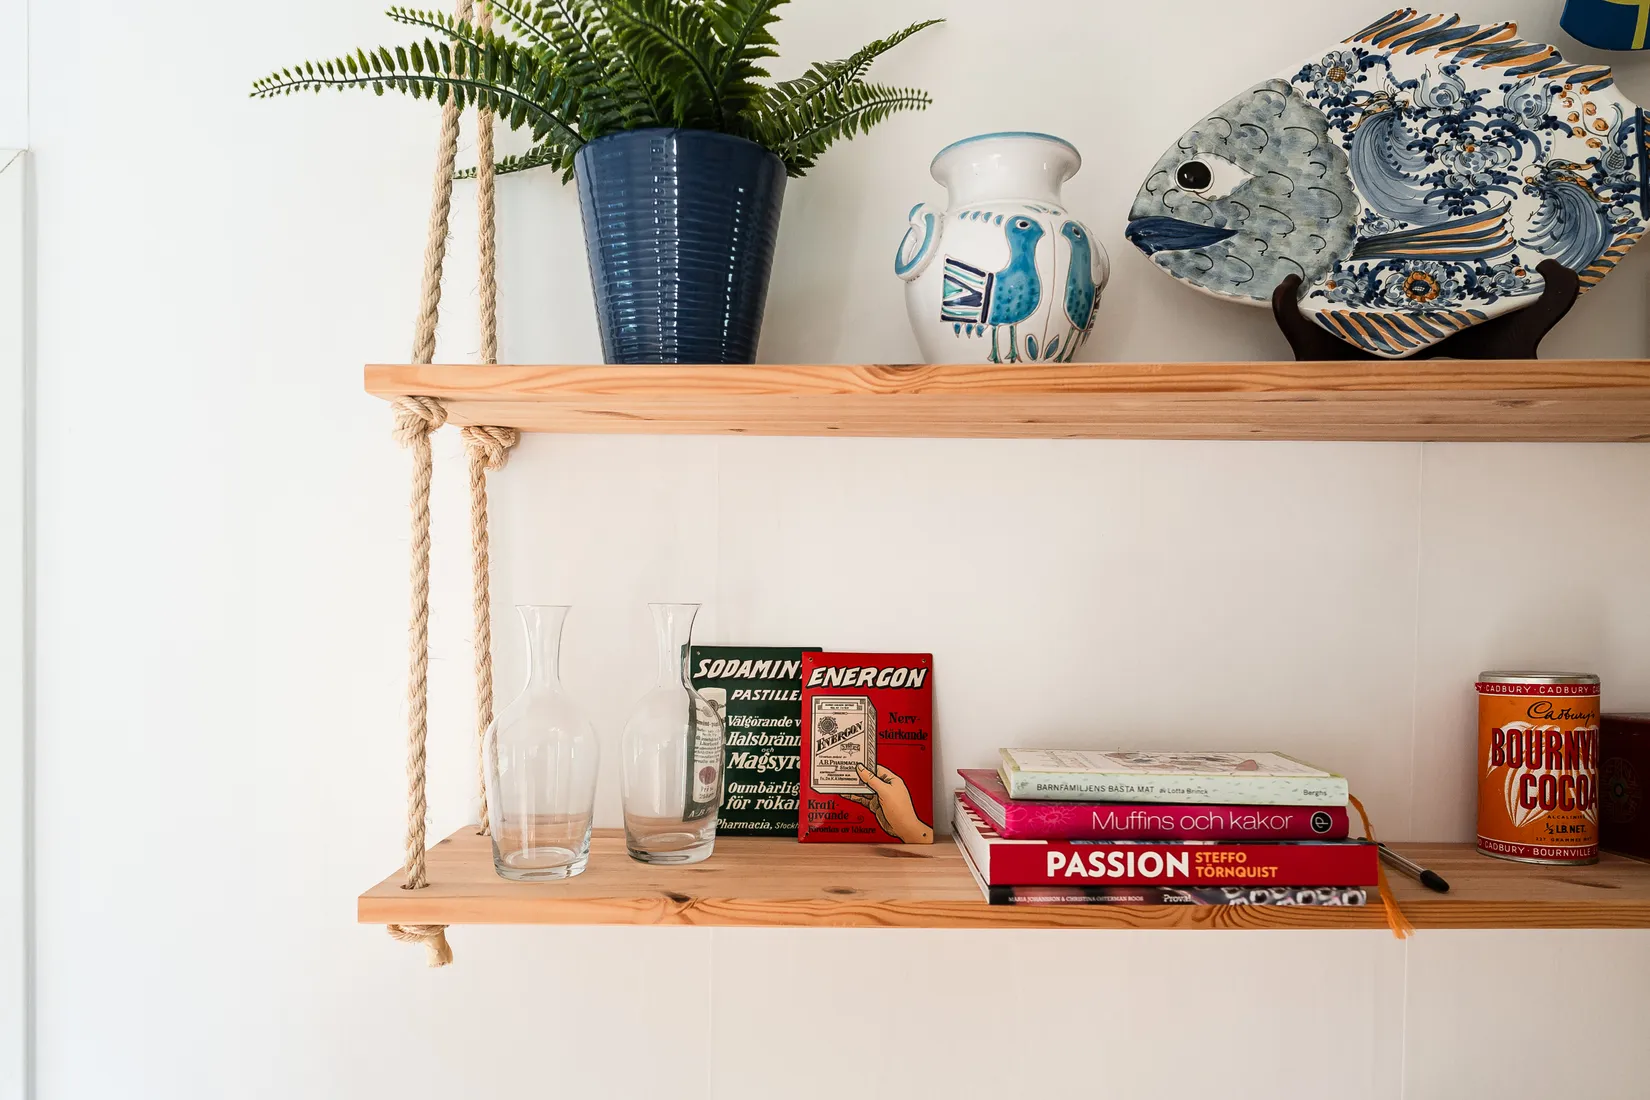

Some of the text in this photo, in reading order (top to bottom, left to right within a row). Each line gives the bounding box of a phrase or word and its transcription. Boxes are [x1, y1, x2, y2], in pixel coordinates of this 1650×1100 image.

[693, 659, 802, 679] SODAMIN
[806, 667, 928, 688] ENERGON
[731, 689, 802, 701] PASTILLE
[1485, 685, 1531, 693] CADBURY
[1540, 685, 1589, 694] CADBURY
[889, 712, 920, 724] Nerv-
[1527, 700, 1596, 727] Cadbury's
[728, 715, 792, 728] Välgörande
[816, 721, 863, 751] ENERGON
[879, 729, 928, 741] stärkande
[1037, 783, 1106, 793] BARNFAMILJENS
[1303, 789, 1328, 797] Berghs
[1520, 774, 1597, 811] COCOA
[726, 795, 751, 810] för
[808, 799, 839, 810] Kraft-
[808, 810, 848, 822] givande
[1092, 811, 1293, 830] Muffins och kakor
[1485, 840, 1525, 854] CADBURY
[1533, 848, 1591, 857] BOURNVILLE
[1195, 851, 1247, 863] STEFFO
[1047, 851, 1189, 878] PASSION
[1195, 864, 1279, 878] TÖRNQUIST
